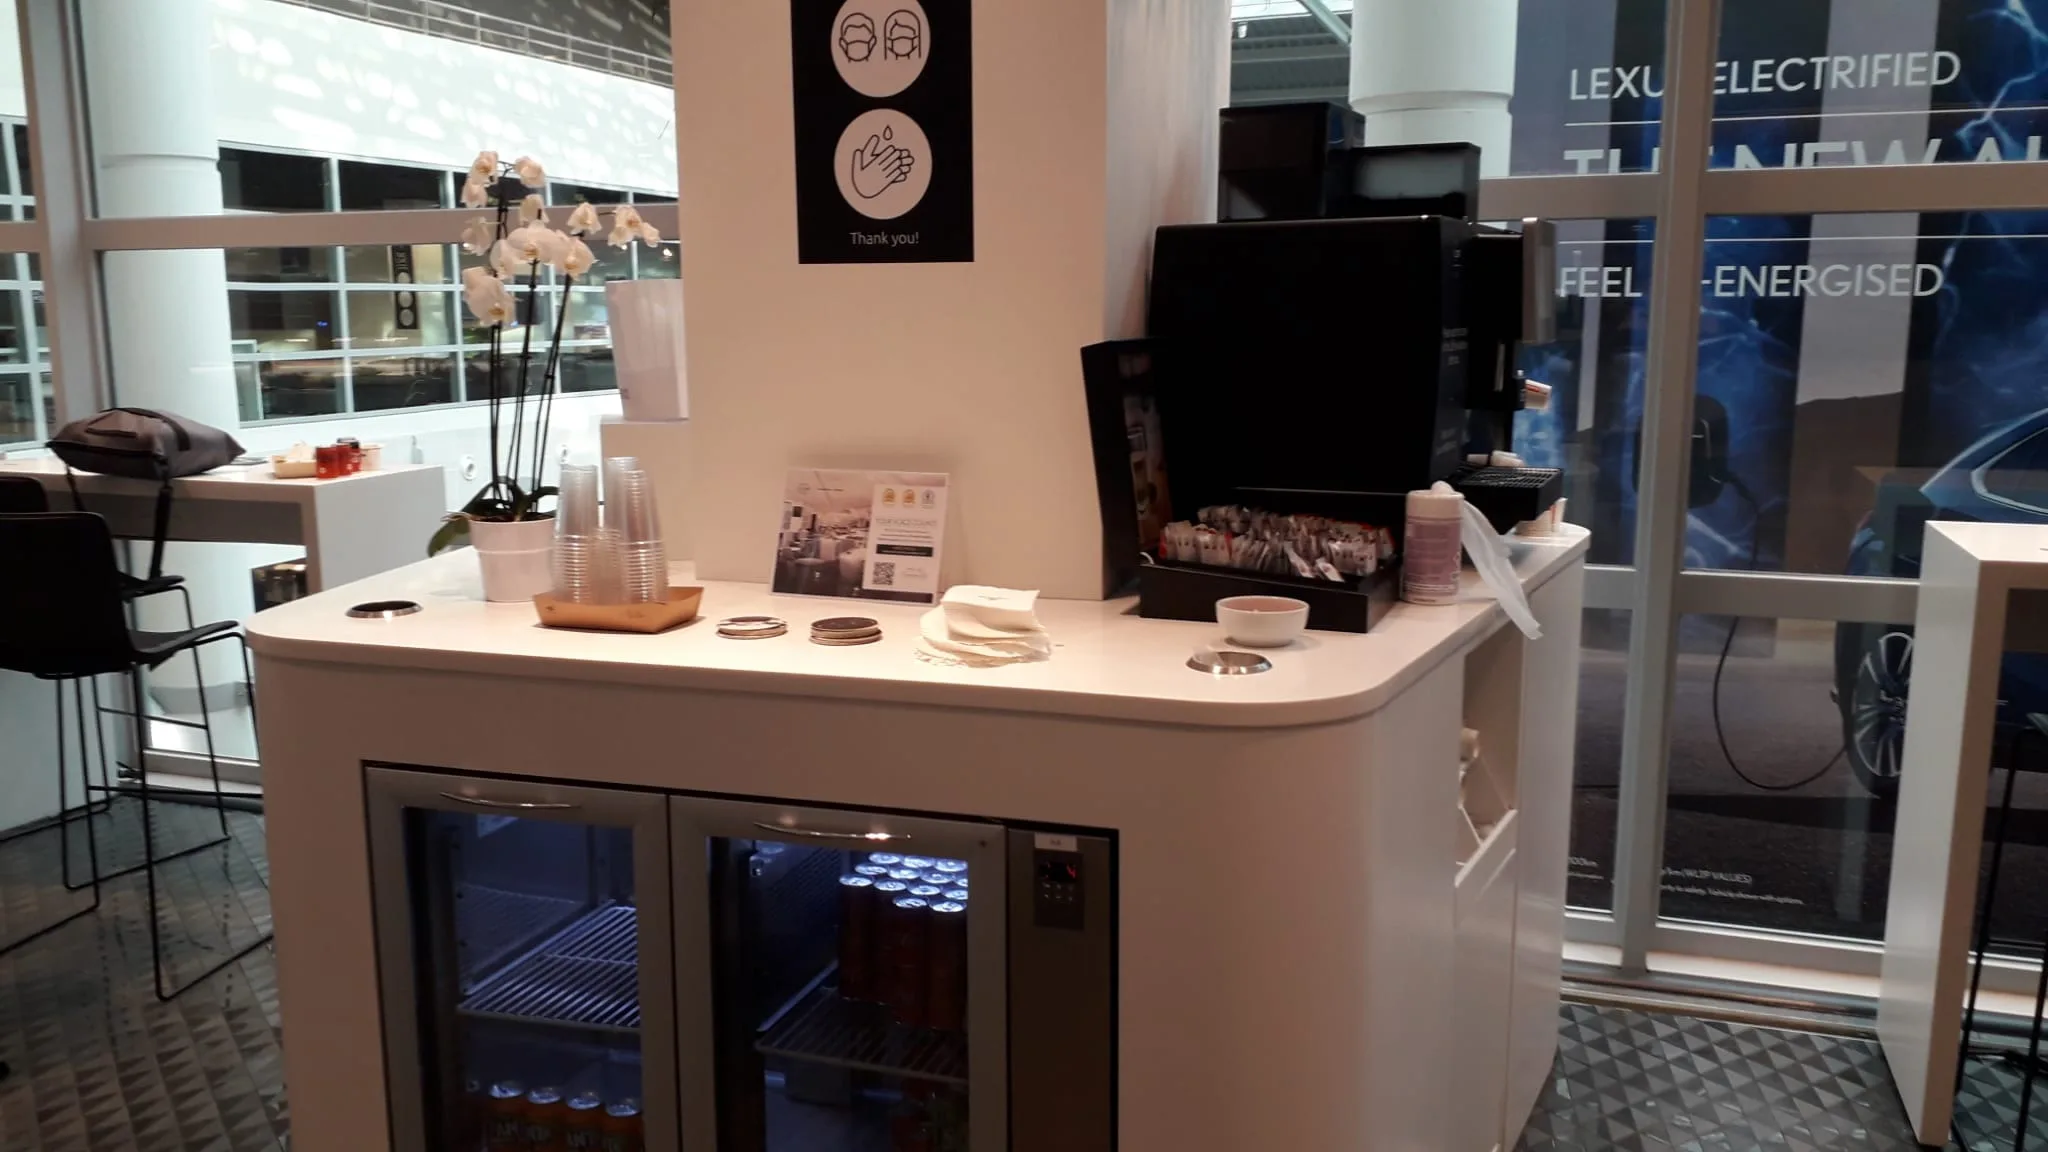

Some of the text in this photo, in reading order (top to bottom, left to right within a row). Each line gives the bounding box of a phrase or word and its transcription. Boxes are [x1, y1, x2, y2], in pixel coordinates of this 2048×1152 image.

[1569, 51, 1961, 100] LEXU ELECTRIFIED
[849, 231, 919, 247] Thank you!
[1559, 263, 1944, 298] FEEL -ENERGISED
